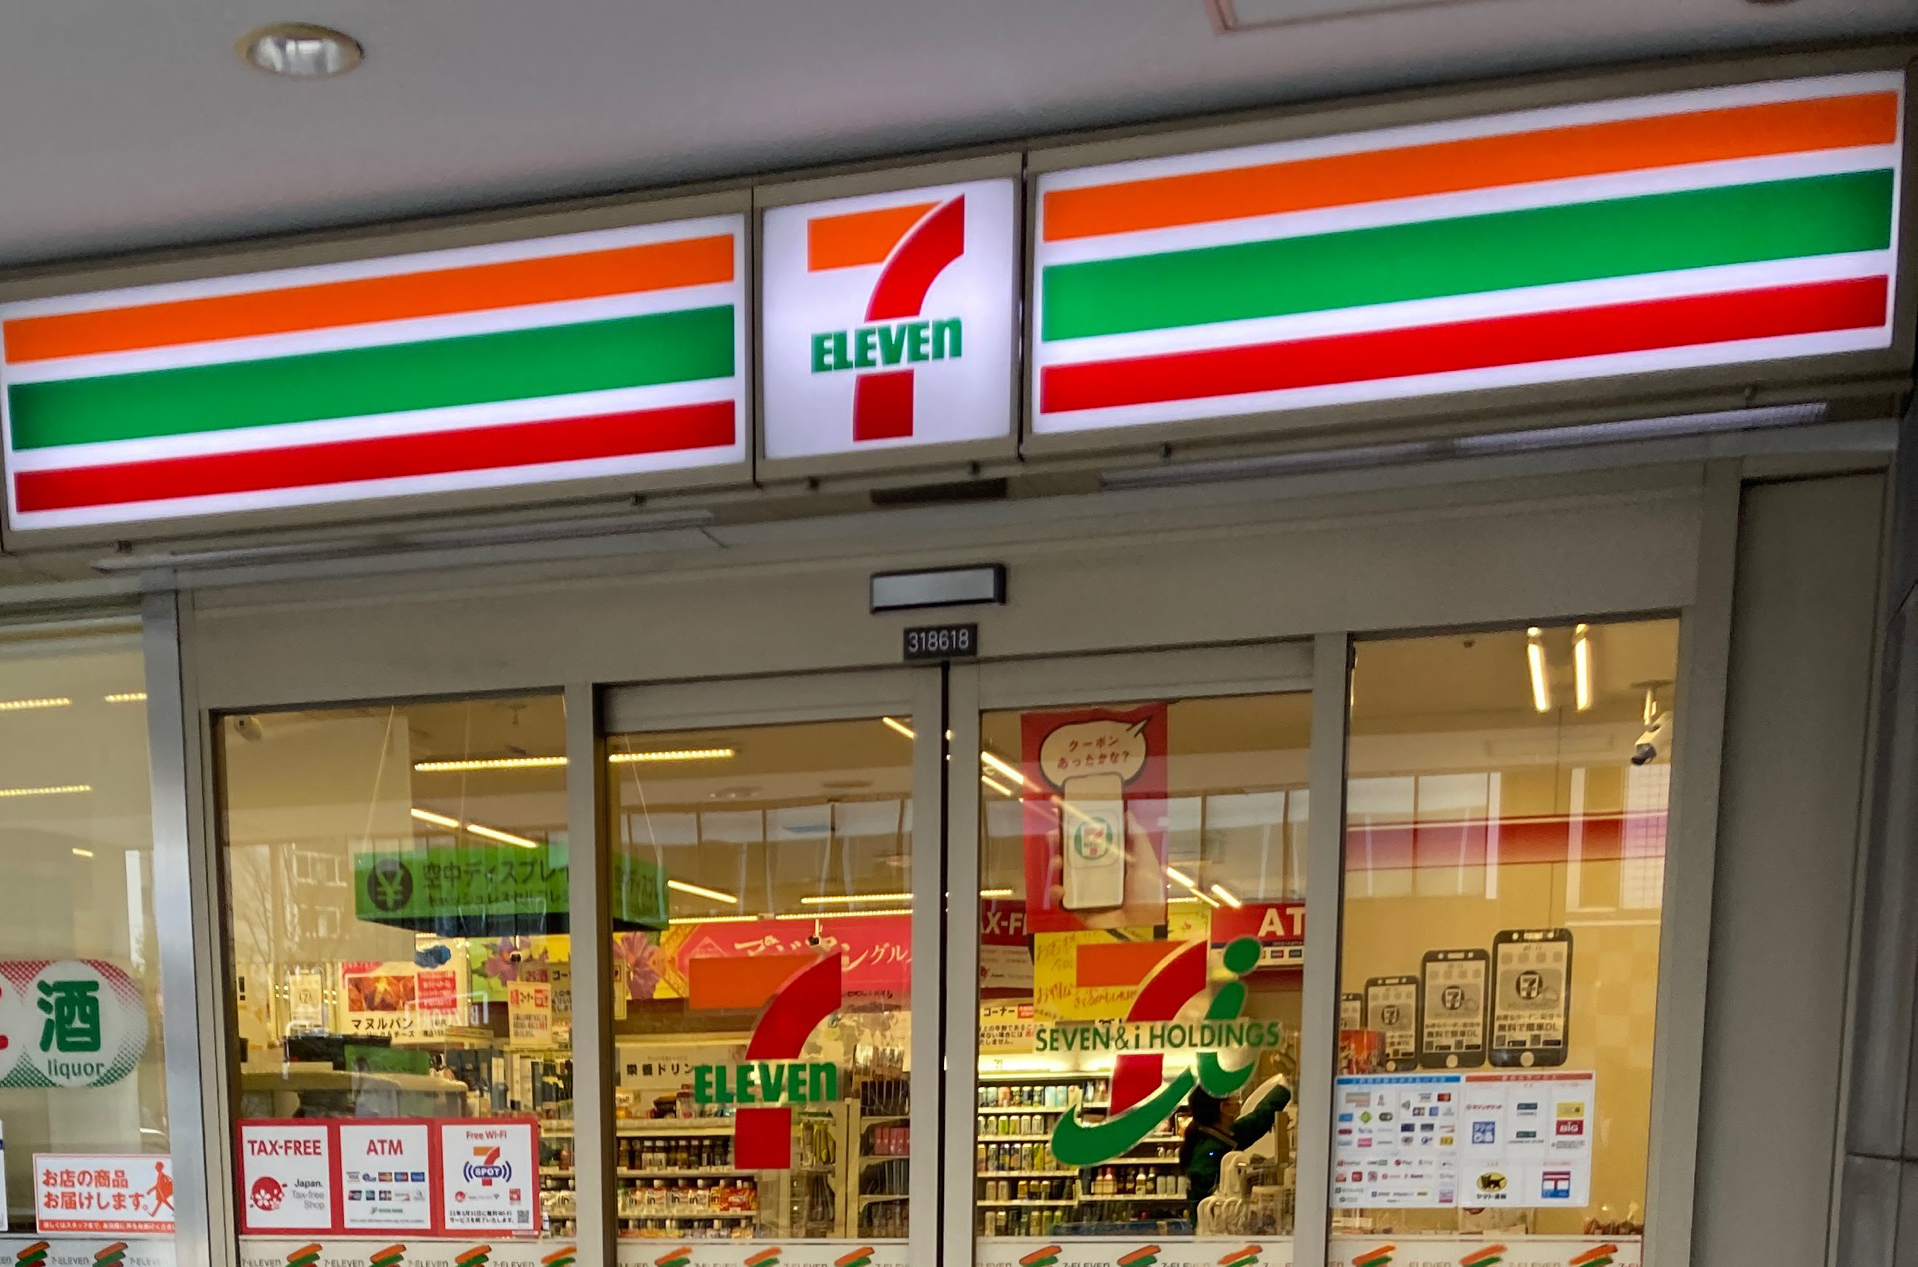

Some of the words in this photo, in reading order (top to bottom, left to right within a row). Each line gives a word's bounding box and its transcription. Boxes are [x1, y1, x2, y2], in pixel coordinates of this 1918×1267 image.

[907, 628, 970, 654] 318618
[1069, 735, 1120, 752] クーポン
[1257, 906, 1307, 938] AT
[37, 980, 101, 1053] 酒
[983, 1005, 1016, 1017] コーナー
[1149, 1021, 1280, 1049] HOLDINGS
[47, 1058, 106, 1080] liquor
[626, 1063, 695, 1077] 栄養ドリン
[466, 1131, 484, 1140] Free
[247, 1139, 322, 1157] TAX-FREE
[366, 1139, 404, 1156] ATM
[42, 1168, 129, 1189] お店の商品
[475, 1167, 501, 1176] SPOT
[294, 1178, 324, 1189] Japan.
[44, 1191, 149, 1212] お届けします。
[292, 1190, 325, 1200] Tax-free
[303, 1201, 325, 1210] Shop
